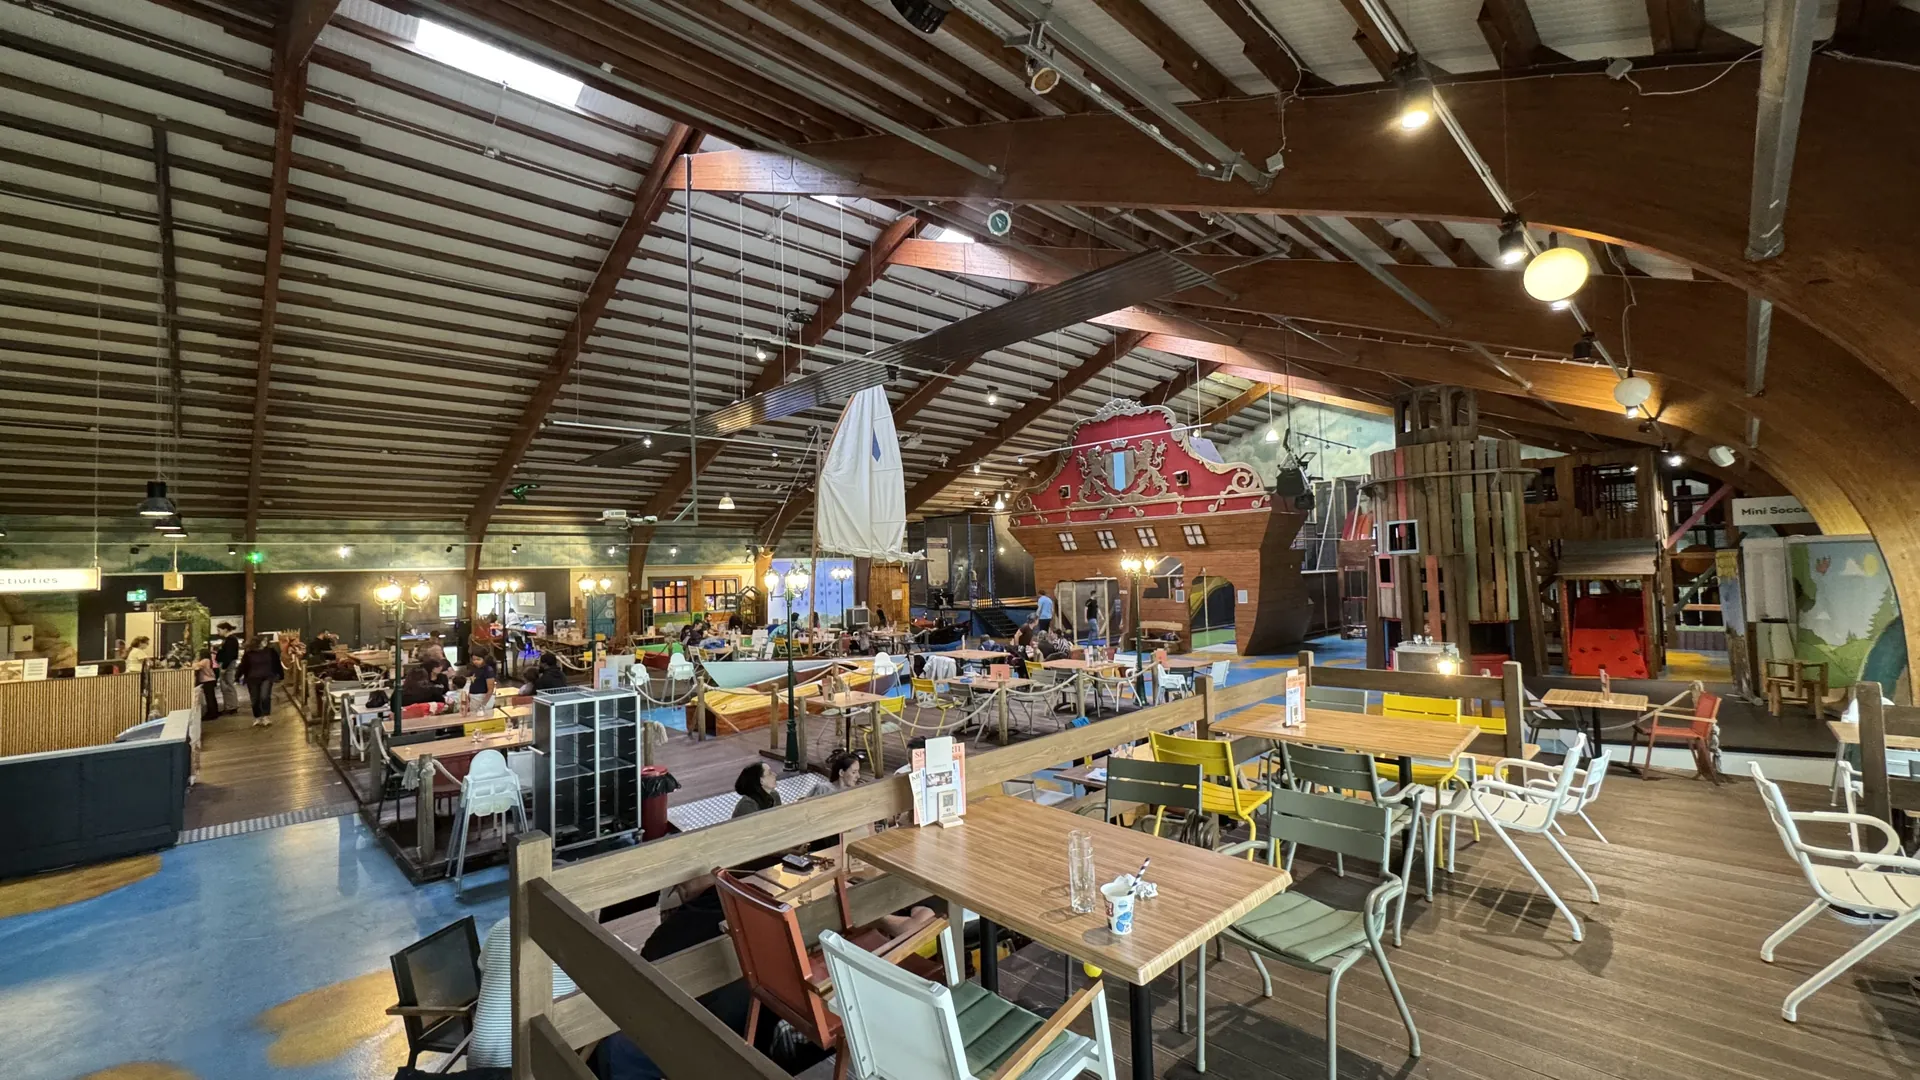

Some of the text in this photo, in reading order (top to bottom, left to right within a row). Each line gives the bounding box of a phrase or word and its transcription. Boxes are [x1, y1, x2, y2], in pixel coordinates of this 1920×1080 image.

[1741, 506, 1808, 515] Mini Socce
[0, 577, 58, 585] ctivities
